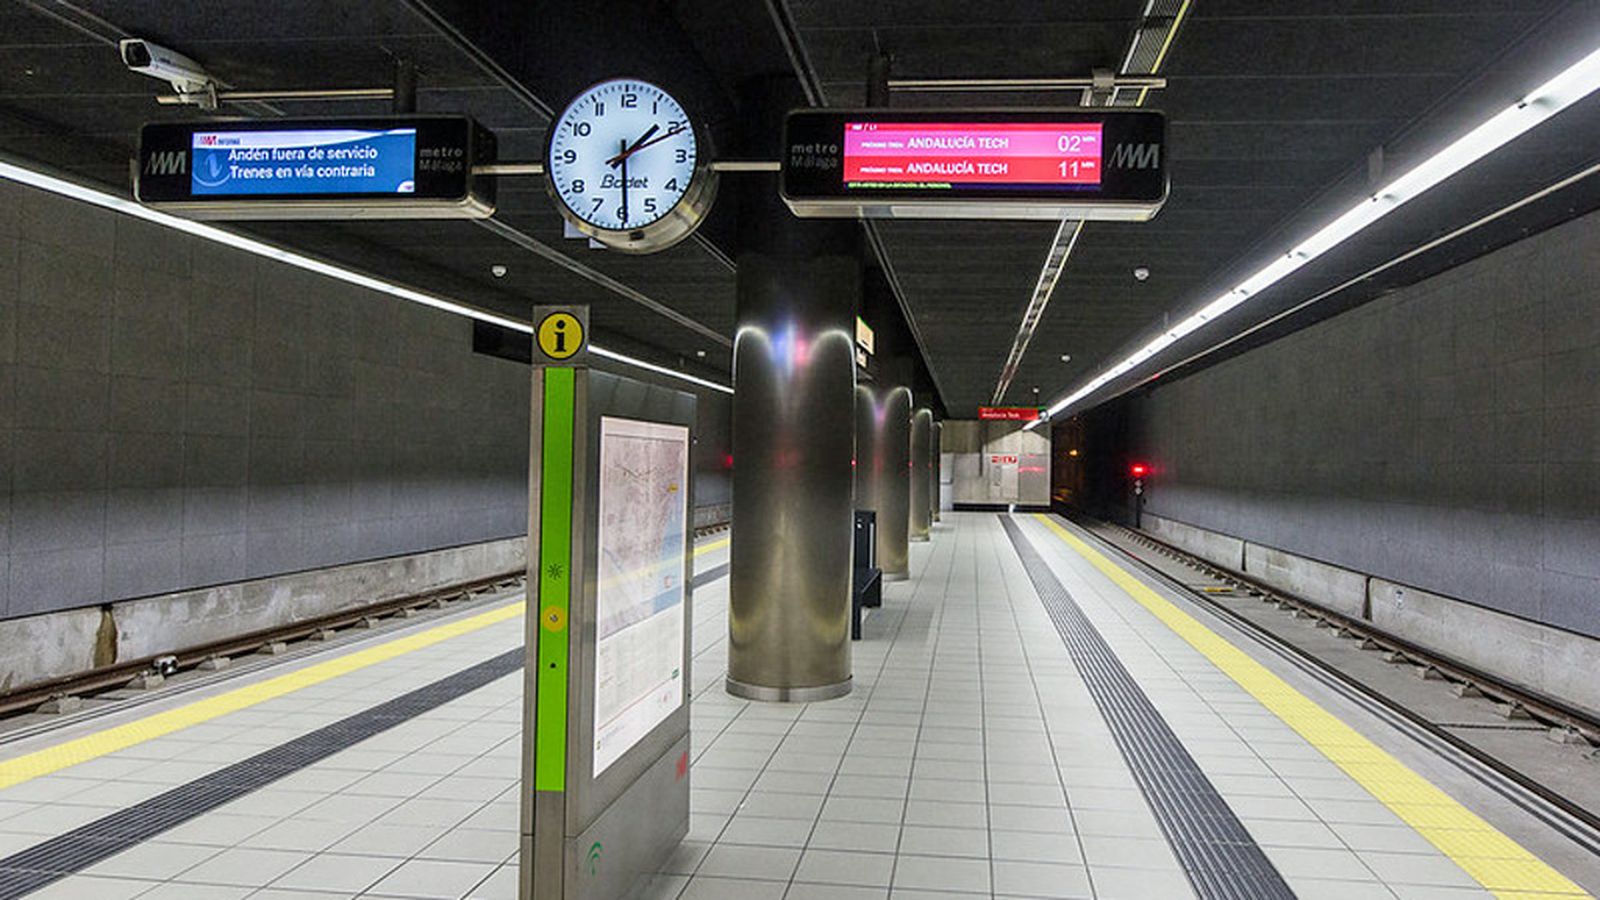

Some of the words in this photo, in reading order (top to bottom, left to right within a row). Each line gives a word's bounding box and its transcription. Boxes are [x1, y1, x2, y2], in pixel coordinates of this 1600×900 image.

[621, 94, 637, 108] 12
[653, 101, 657, 115] 1
[595, 103, 604, 116] 11
[573, 122, 591, 136] 10
[791, 143, 838, 154] metro
[907, 136, 975, 149] ANDALUCÍA
[978, 137, 1009, 149] TECH
[1057, 135, 1081, 153] 02
[228, 147, 269, 161] Andén
[272, 147, 305, 160] fuera
[307, 145, 324, 160] de
[327, 145, 378, 159] servicio
[419, 147, 463, 157] metro
[564, 150, 577, 164] 9
[675, 150, 687, 163] 3
[230, 165, 273, 179] Trenes
[275, 167, 292, 178] en
[294, 163, 314, 178] vía
[316, 163, 375, 177] contraria
[906, 160, 975, 174] ANDALUCÍA
[977, 163, 1008, 174] TECH
[1058, 161, 1079, 177] 11
[571, 179, 585, 193] 8
[600, 174, 648, 188] Bodet
[664, 178, 677, 191] 4
[592, 198, 604, 212] 7
[644, 198, 656, 212] 5
